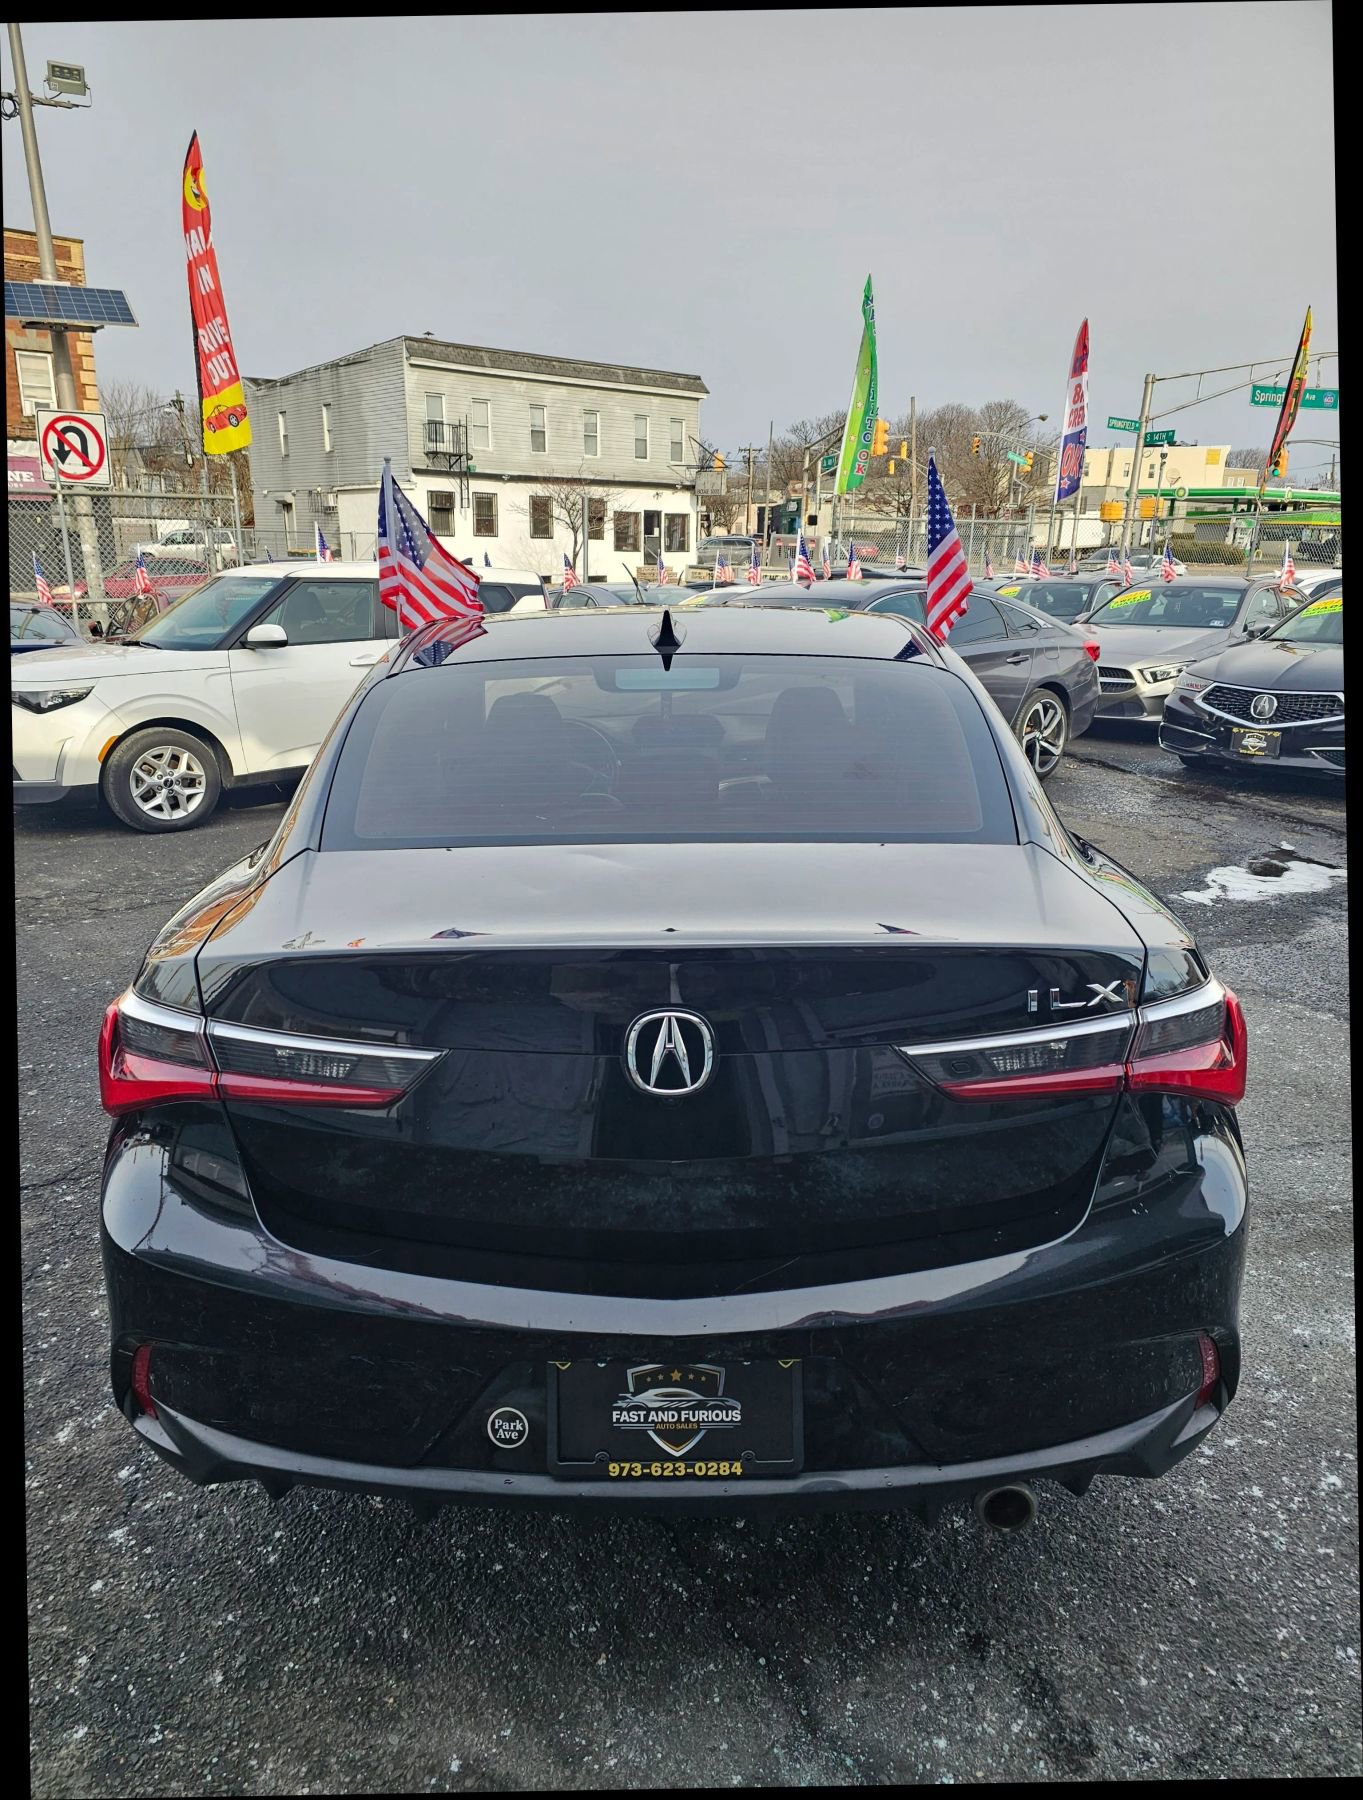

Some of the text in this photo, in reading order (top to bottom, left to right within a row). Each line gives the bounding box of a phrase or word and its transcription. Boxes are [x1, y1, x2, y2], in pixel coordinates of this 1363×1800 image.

[197, 264, 215, 295] IN
[198, 316, 230, 354] RIVE
[1254, 389, 1317, 405] Springf Ave
[1108, 418, 1136, 430] SPRINGFIELD
[1146, 433, 1151, 442] S
[1153, 432, 1167, 441] 14TH
[1028, 980, 1124, 1012] ILX
[612, 1409, 741, 1423] FAST AND FURIOUS
[494, 1418, 524, 1431] Park
[655, 1422, 698, 1430] AUTO SALES
[496, 1428, 519, 1440] Ave
[608, 1462, 743, 1477] 973-623-0284
